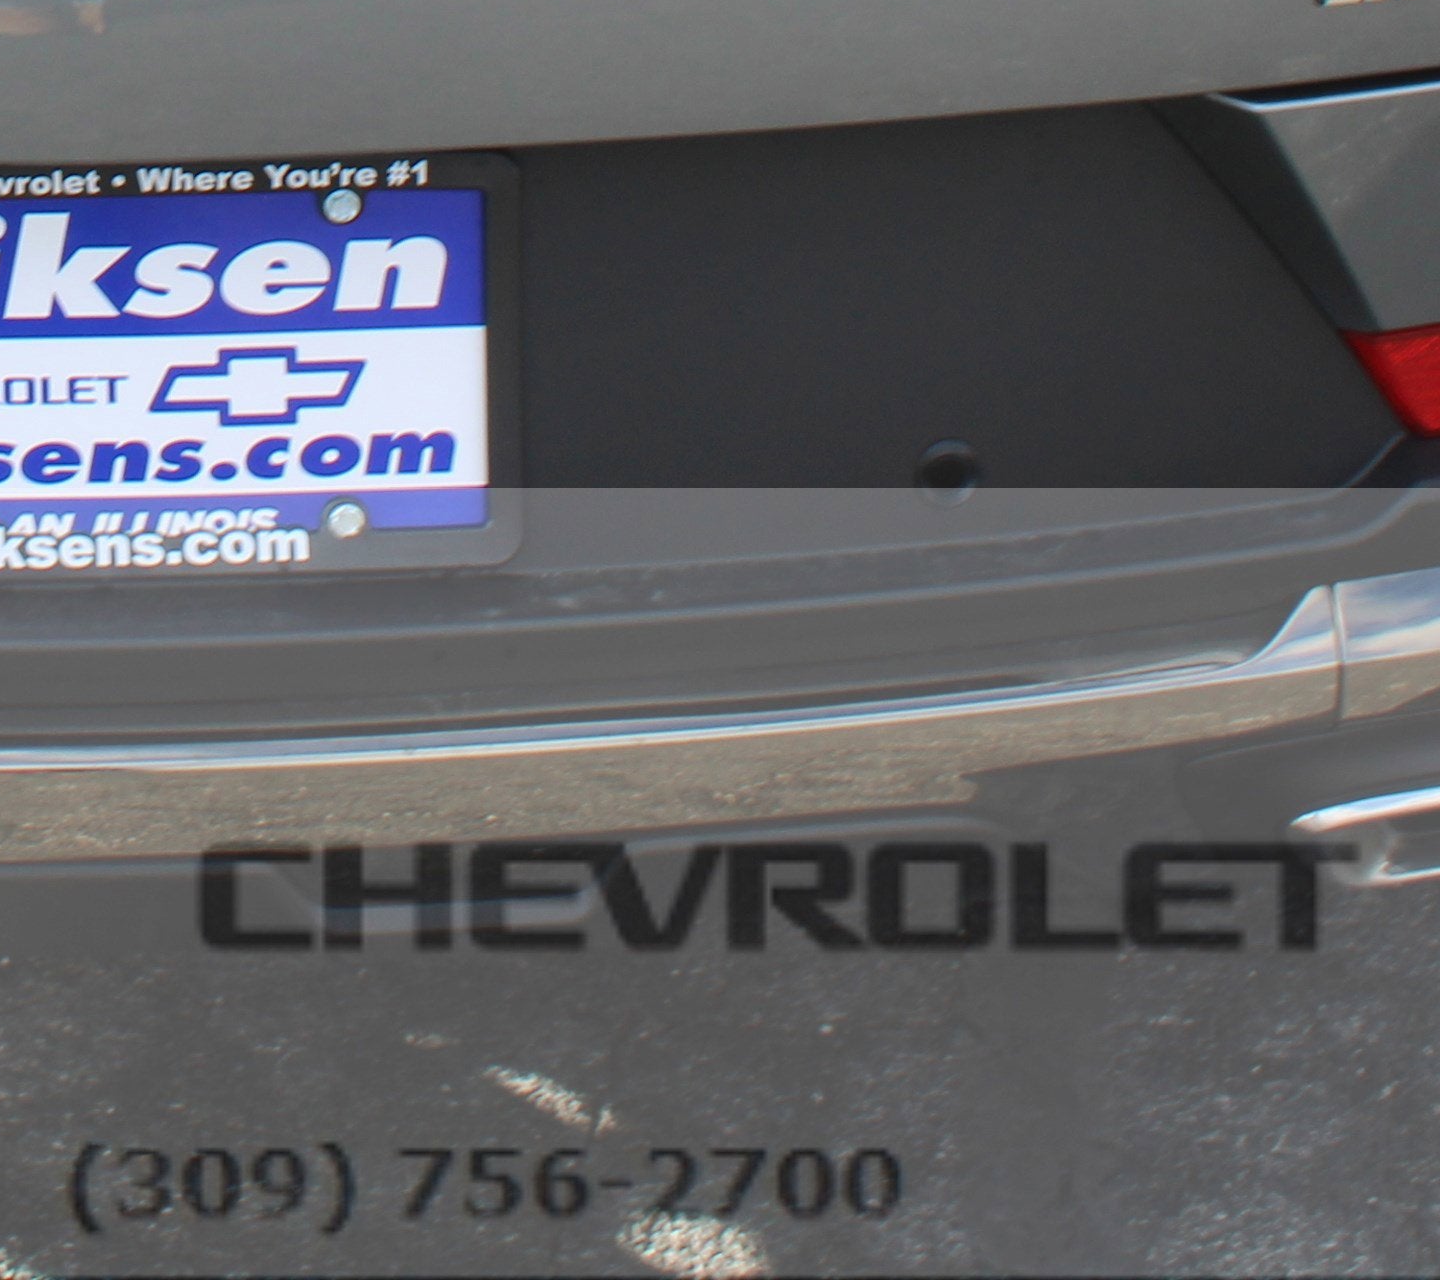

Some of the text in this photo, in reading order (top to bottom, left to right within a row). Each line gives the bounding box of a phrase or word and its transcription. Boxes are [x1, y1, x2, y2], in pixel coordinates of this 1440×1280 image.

[136, 165, 255, 194] Where
[265, 162, 379, 190] You're
[386, 159, 430, 187] #1
